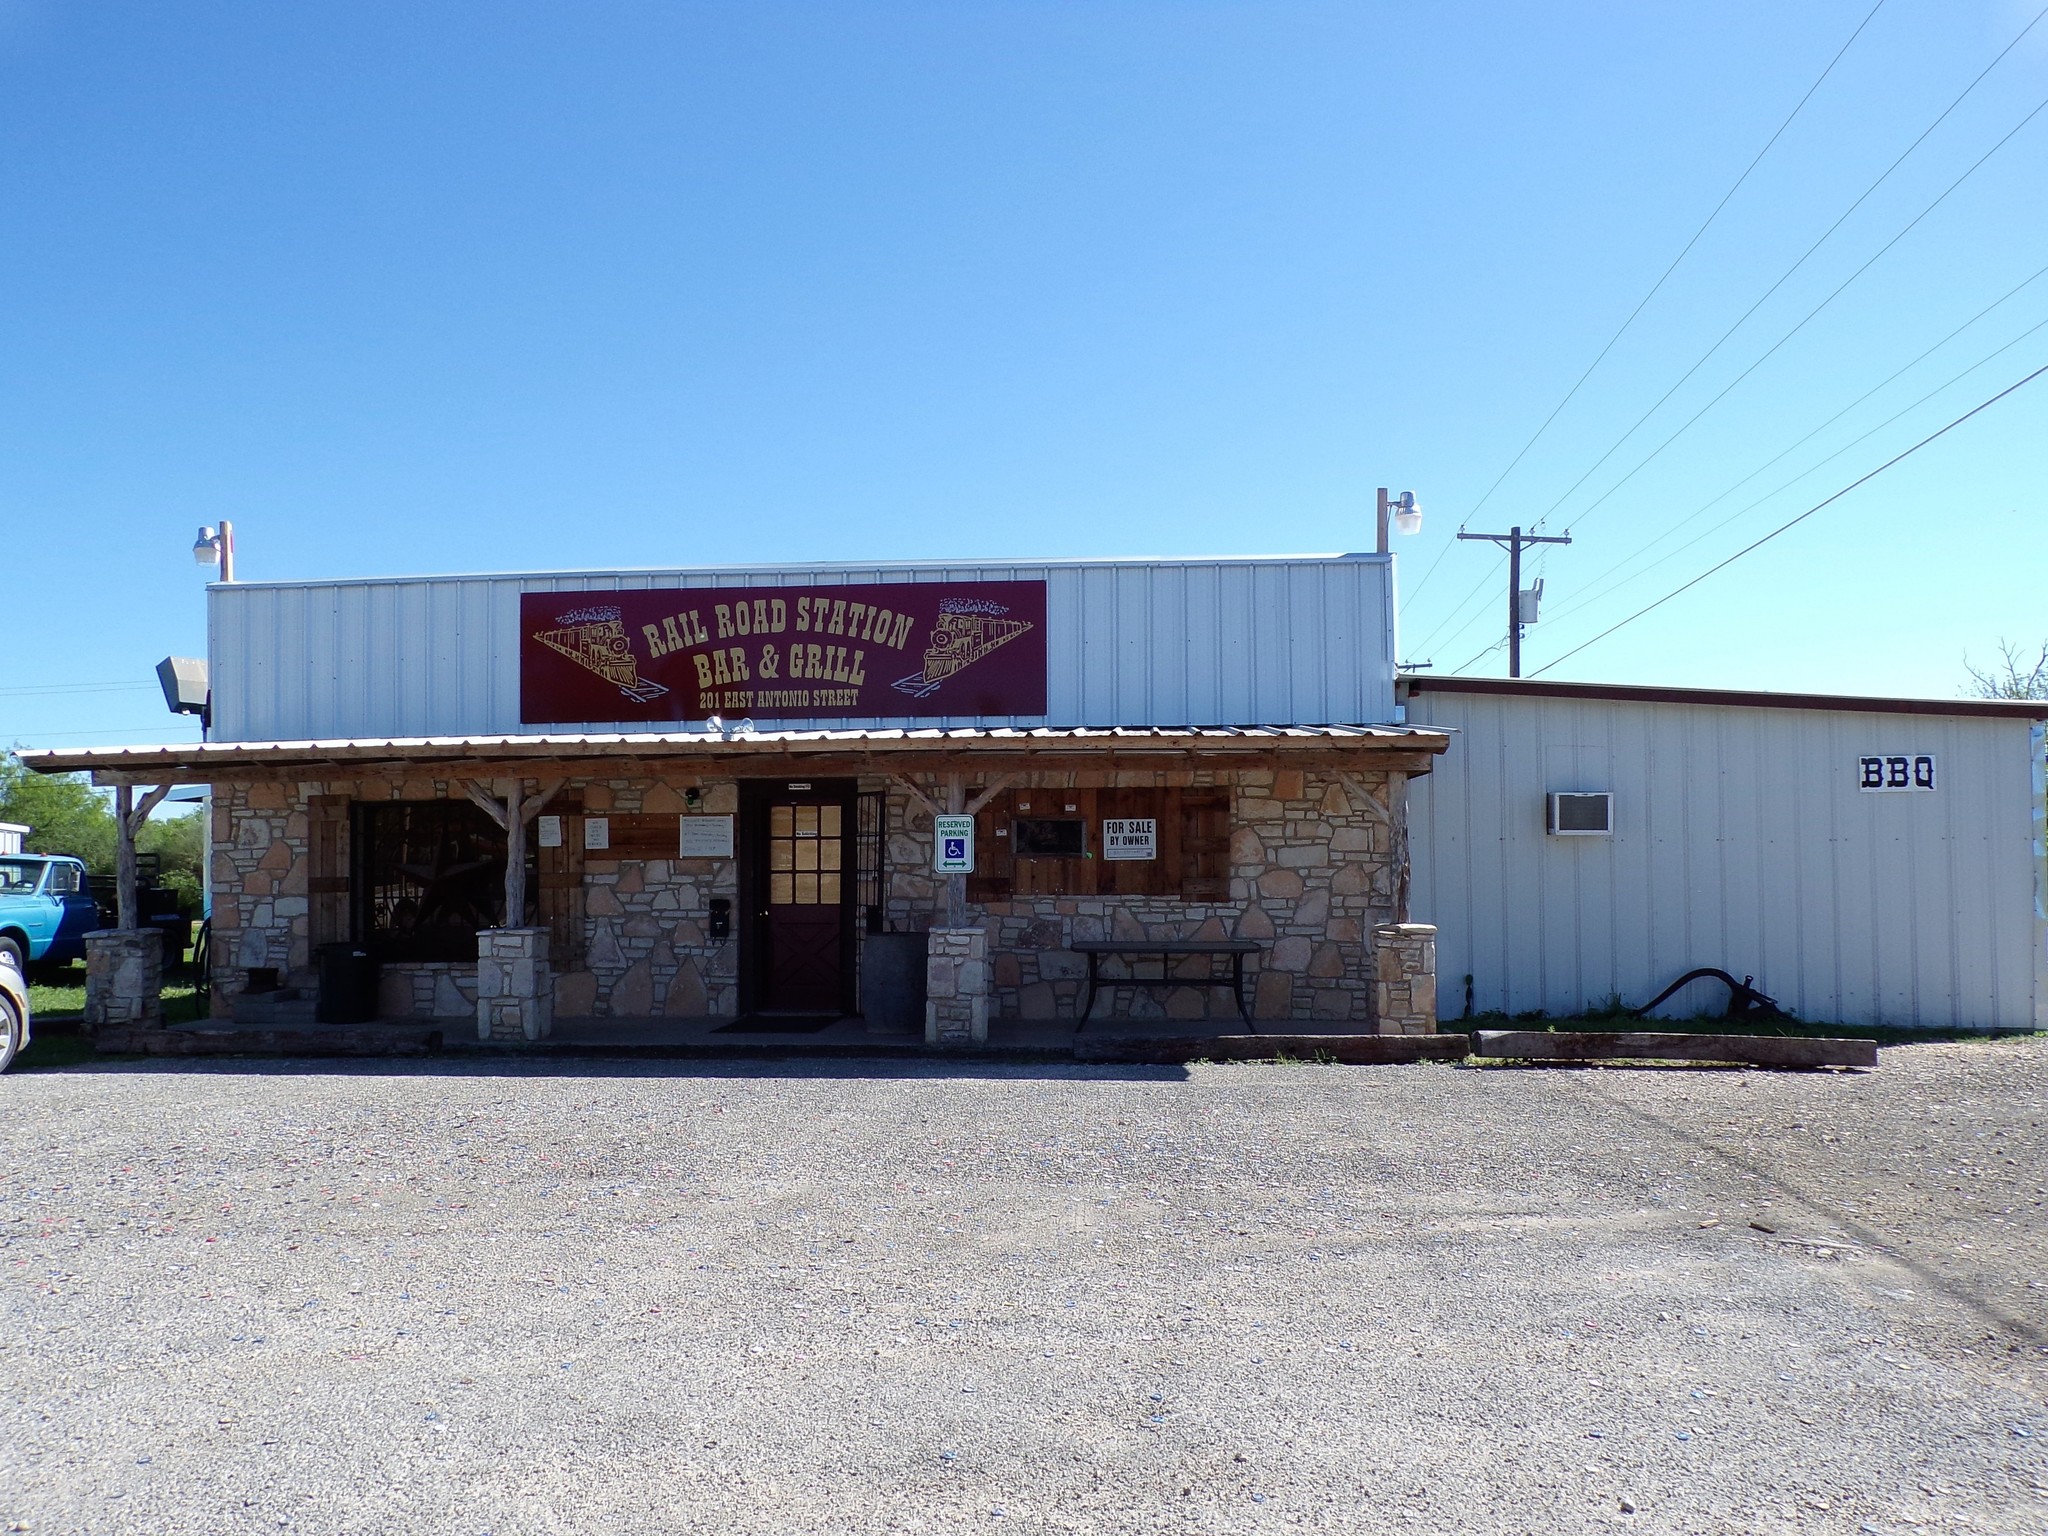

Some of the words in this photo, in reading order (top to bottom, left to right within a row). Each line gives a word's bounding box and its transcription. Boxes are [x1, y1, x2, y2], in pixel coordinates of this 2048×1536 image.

[641, 610, 709, 659] RAIL
[714, 599, 787, 639] ROAD
[795, 596, 915, 650] STATION
[693, 647, 750, 690] BAR
[758, 643, 780, 679] &
[789, 643, 866, 687] GRILL
[700, 692, 720, 709] 201
[724, 691, 754, 708] EAST
[757, 690, 809, 708] ANTONIO
[812, 689, 859, 707] STREET
[1860, 756, 1934, 789] BBQ
[938, 820, 970, 828] RESERVED
[1106, 821, 1124, 834] FOR
[1128, 821, 1152, 833] SALE
[940, 829, 969, 837] PARKING
[1110, 836, 1119, 845] BY
[1122, 835, 1149, 845] OWNER
